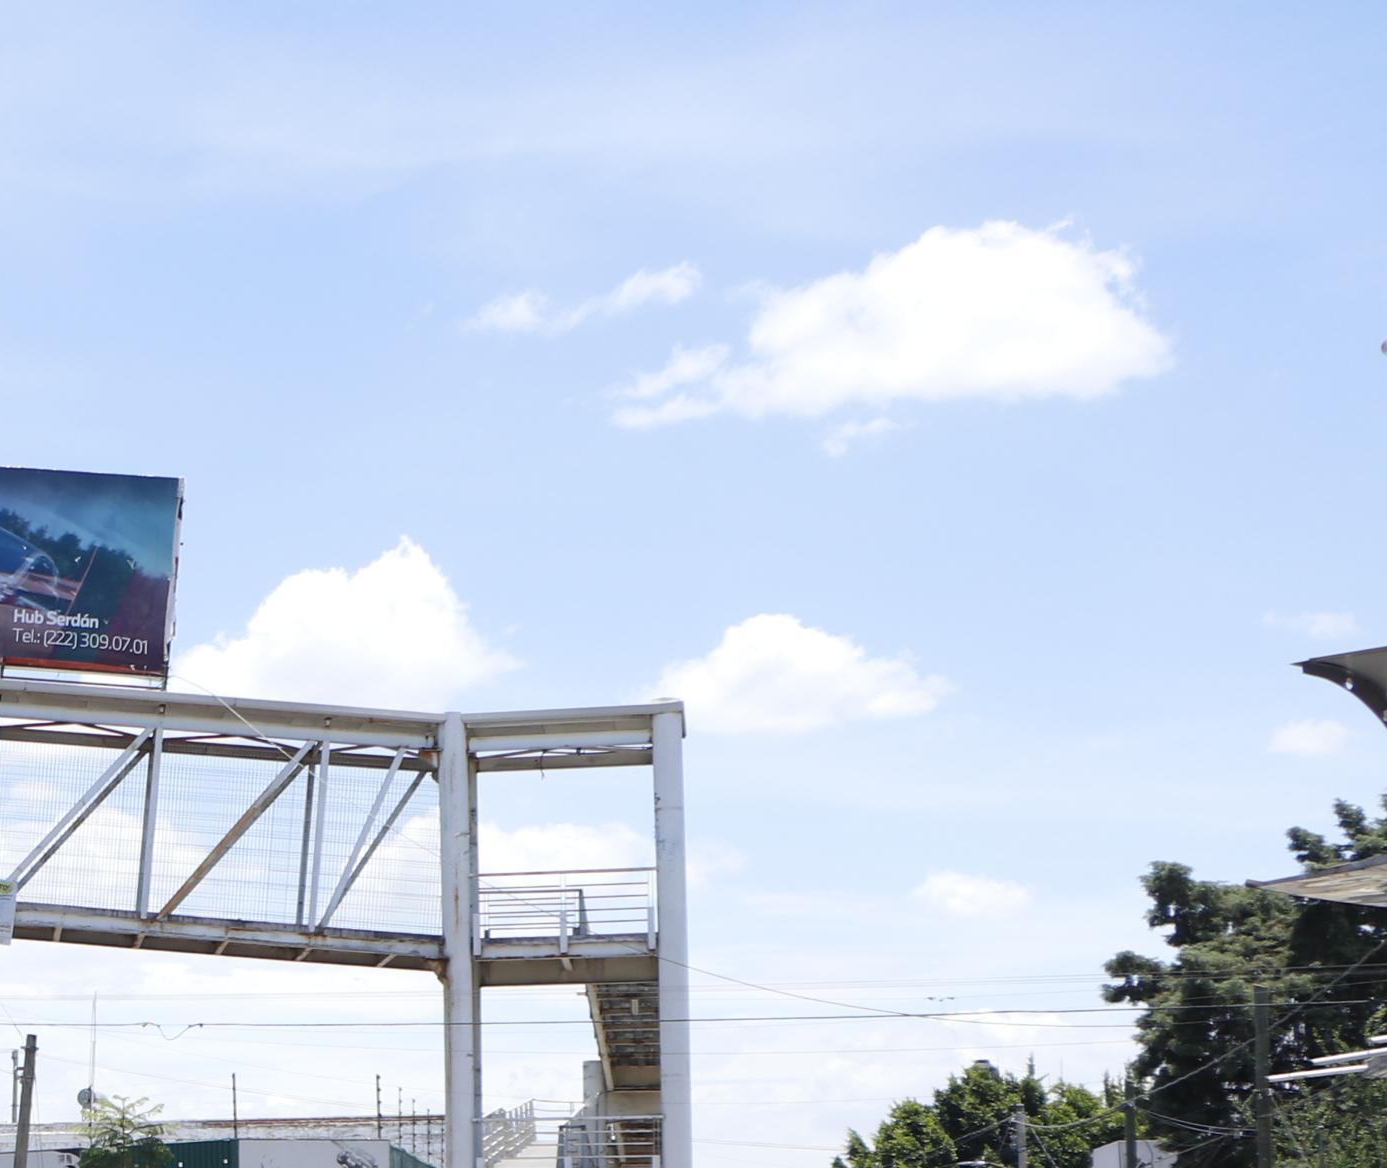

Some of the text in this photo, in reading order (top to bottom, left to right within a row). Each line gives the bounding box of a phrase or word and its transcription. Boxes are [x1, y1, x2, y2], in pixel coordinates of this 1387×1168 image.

[13, 608, 99, 630] Hub Serdán
[12, 628, 149, 656] Tel.: (222) 309.07.01
